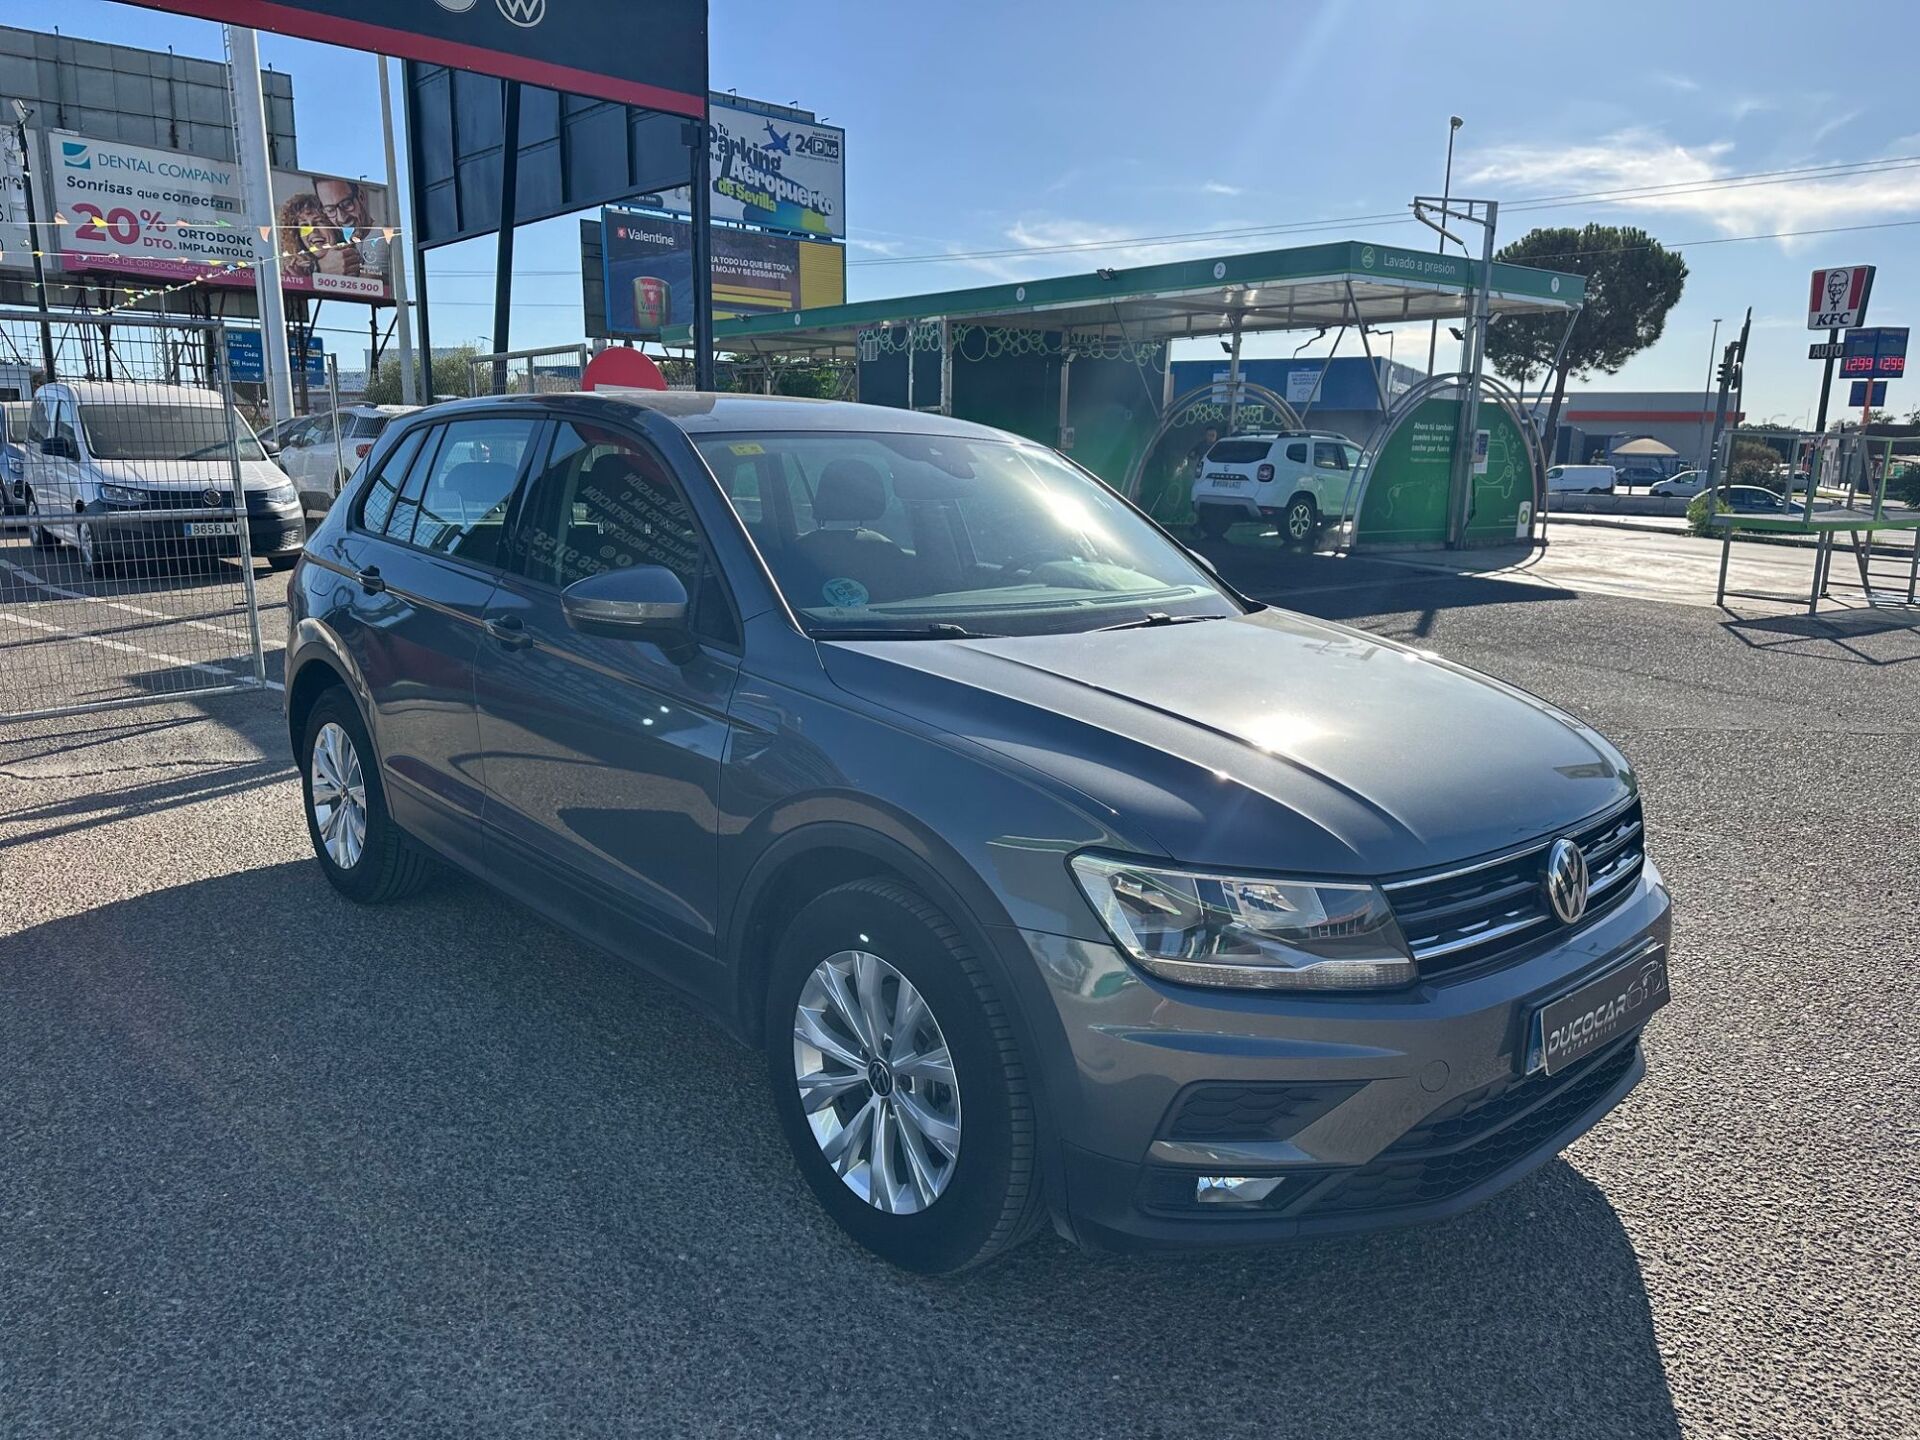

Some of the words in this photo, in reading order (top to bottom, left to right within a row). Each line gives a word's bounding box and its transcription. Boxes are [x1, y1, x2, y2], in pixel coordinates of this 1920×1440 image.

[717, 122, 729, 136] Tu
[97, 152, 155, 174] DENTAL
[158, 163, 231, 185] COMPANY
[66, 175, 133, 196] Sonrisas
[137, 189, 160, 201] que
[163, 191, 233, 210] conectan
[729, 156, 834, 214] Aeropuerto
[718, 178, 735, 195] de
[736, 180, 777, 212] Sevilla
[71, 202, 167, 245] 20%
[143, 236, 177, 250] DTO.
[627, 228, 675, 246] Valentine
[716, 265, 736, 274] MOJA
[737, 267, 742, 275] Y
[719, 256, 739, 266] TODO
[740, 258, 748, 267] LO
[749, 260, 763, 269] QUE
[1383, 252, 1415, 270] Lavado
[1417, 261, 1423, 270] a
[1424, 262, 1456, 275] presión
[318, 278, 337, 288] 900
[340, 280, 358, 290] 926
[360, 282, 379, 292] 900
[1815, 312, 1851, 326] KFC
[1811, 344, 1844, 358] AUTO
